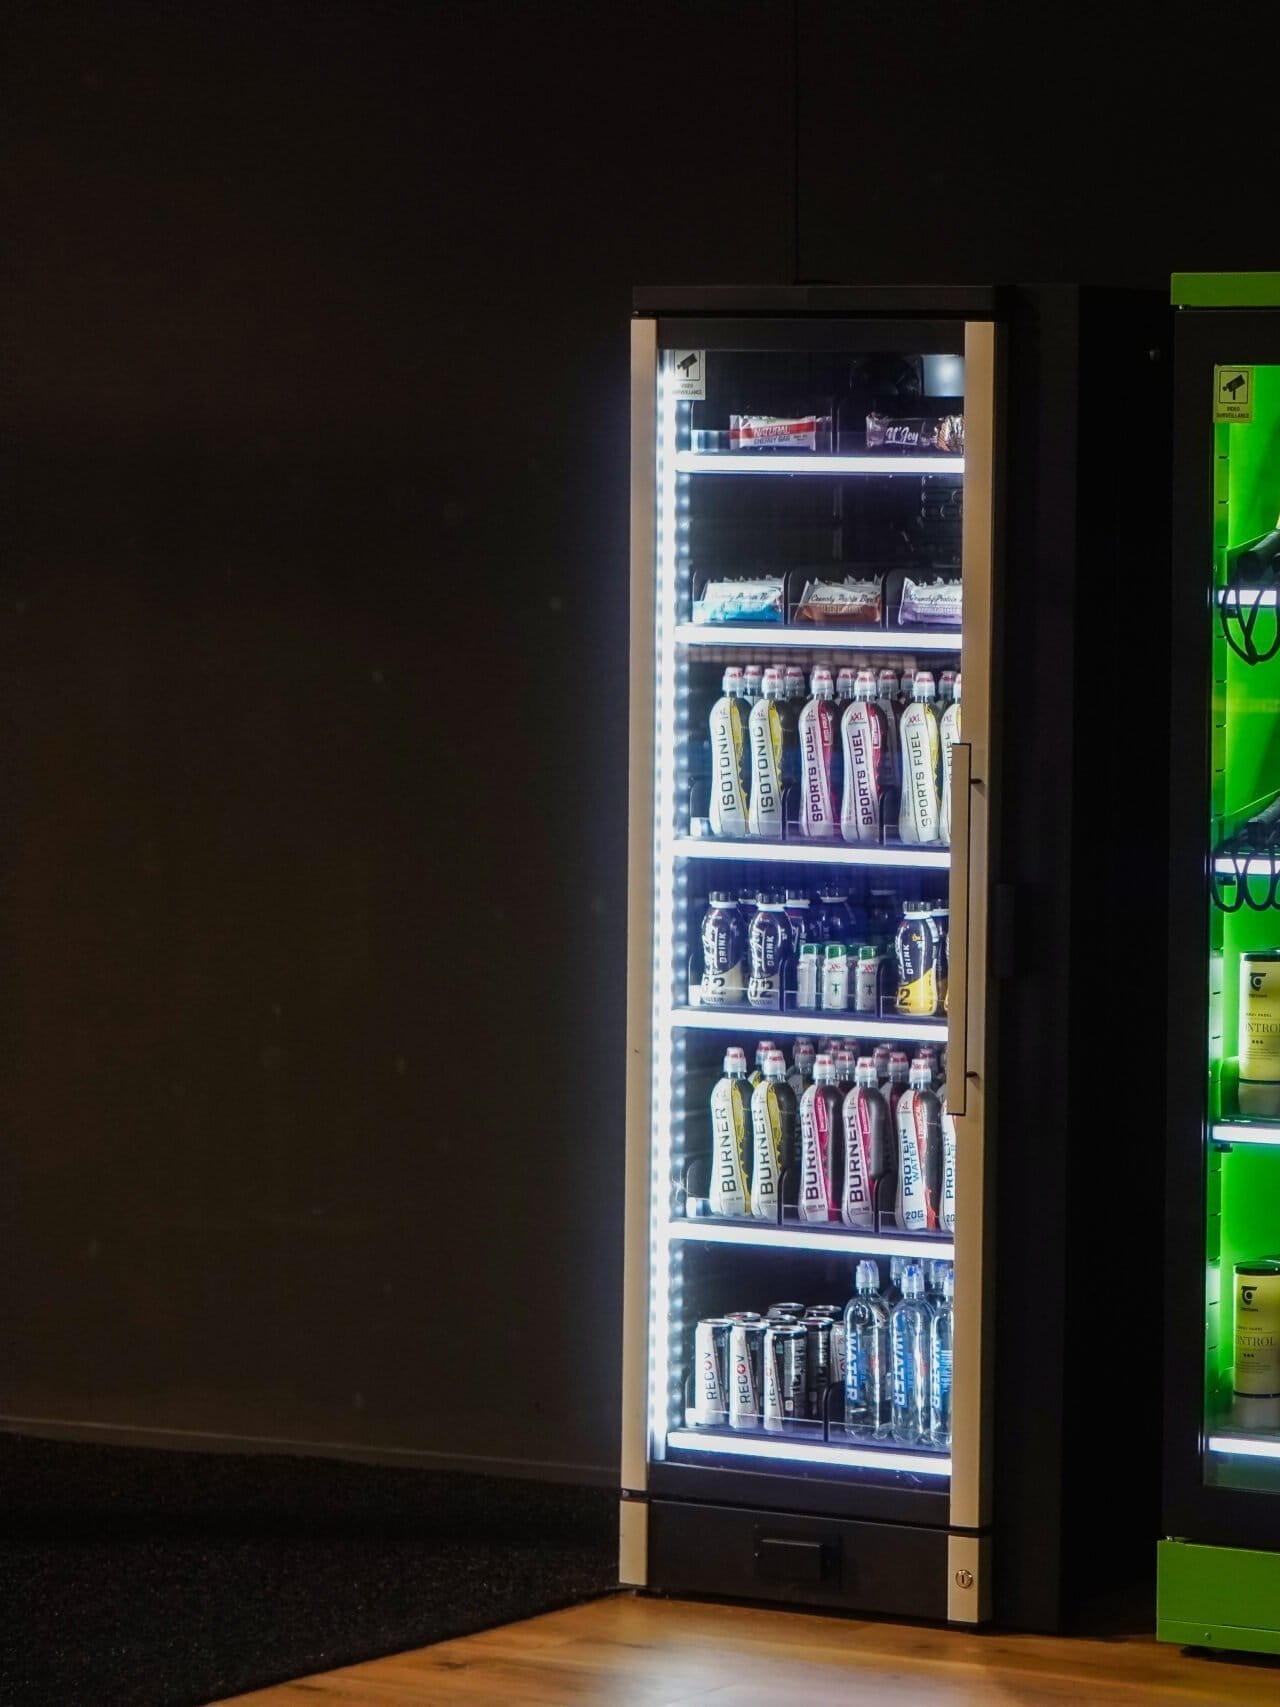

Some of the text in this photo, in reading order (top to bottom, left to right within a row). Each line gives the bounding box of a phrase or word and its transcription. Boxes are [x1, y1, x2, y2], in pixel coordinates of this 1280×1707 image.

[753, 425, 790, 437] NATURAL
[717, 725, 737, 812] ISOTONIC
[754, 725, 775, 814] ISOTONIC
[805, 727, 816, 762] FUEL
[852, 730, 873, 825] SPORTS FUEL
[913, 731, 932, 827] SPORTS FUEL
[808, 767, 823, 822] SPORTS
[718, 932, 728, 964] DRINK
[765, 935, 775, 967] DRINK
[902, 944, 914, 975] DRINK
[715, 1108, 737, 1194] BURNER
[753, 1109, 774, 1196] BURNER
[802, 1111, 819, 1201] BURNER
[847, 1114, 864, 1203] BURNER
[902, 1128, 914, 1197] PROTEIN
[908, 1142, 920, 1182] WATER
[905, 1209, 924, 1220] 20G
[735, 1355, 750, 1404] RECOV
[846, 1331, 858, 1400] WATER
[893, 1335, 906, 1407] WATER
[931, 1340, 941, 1409] WATER
